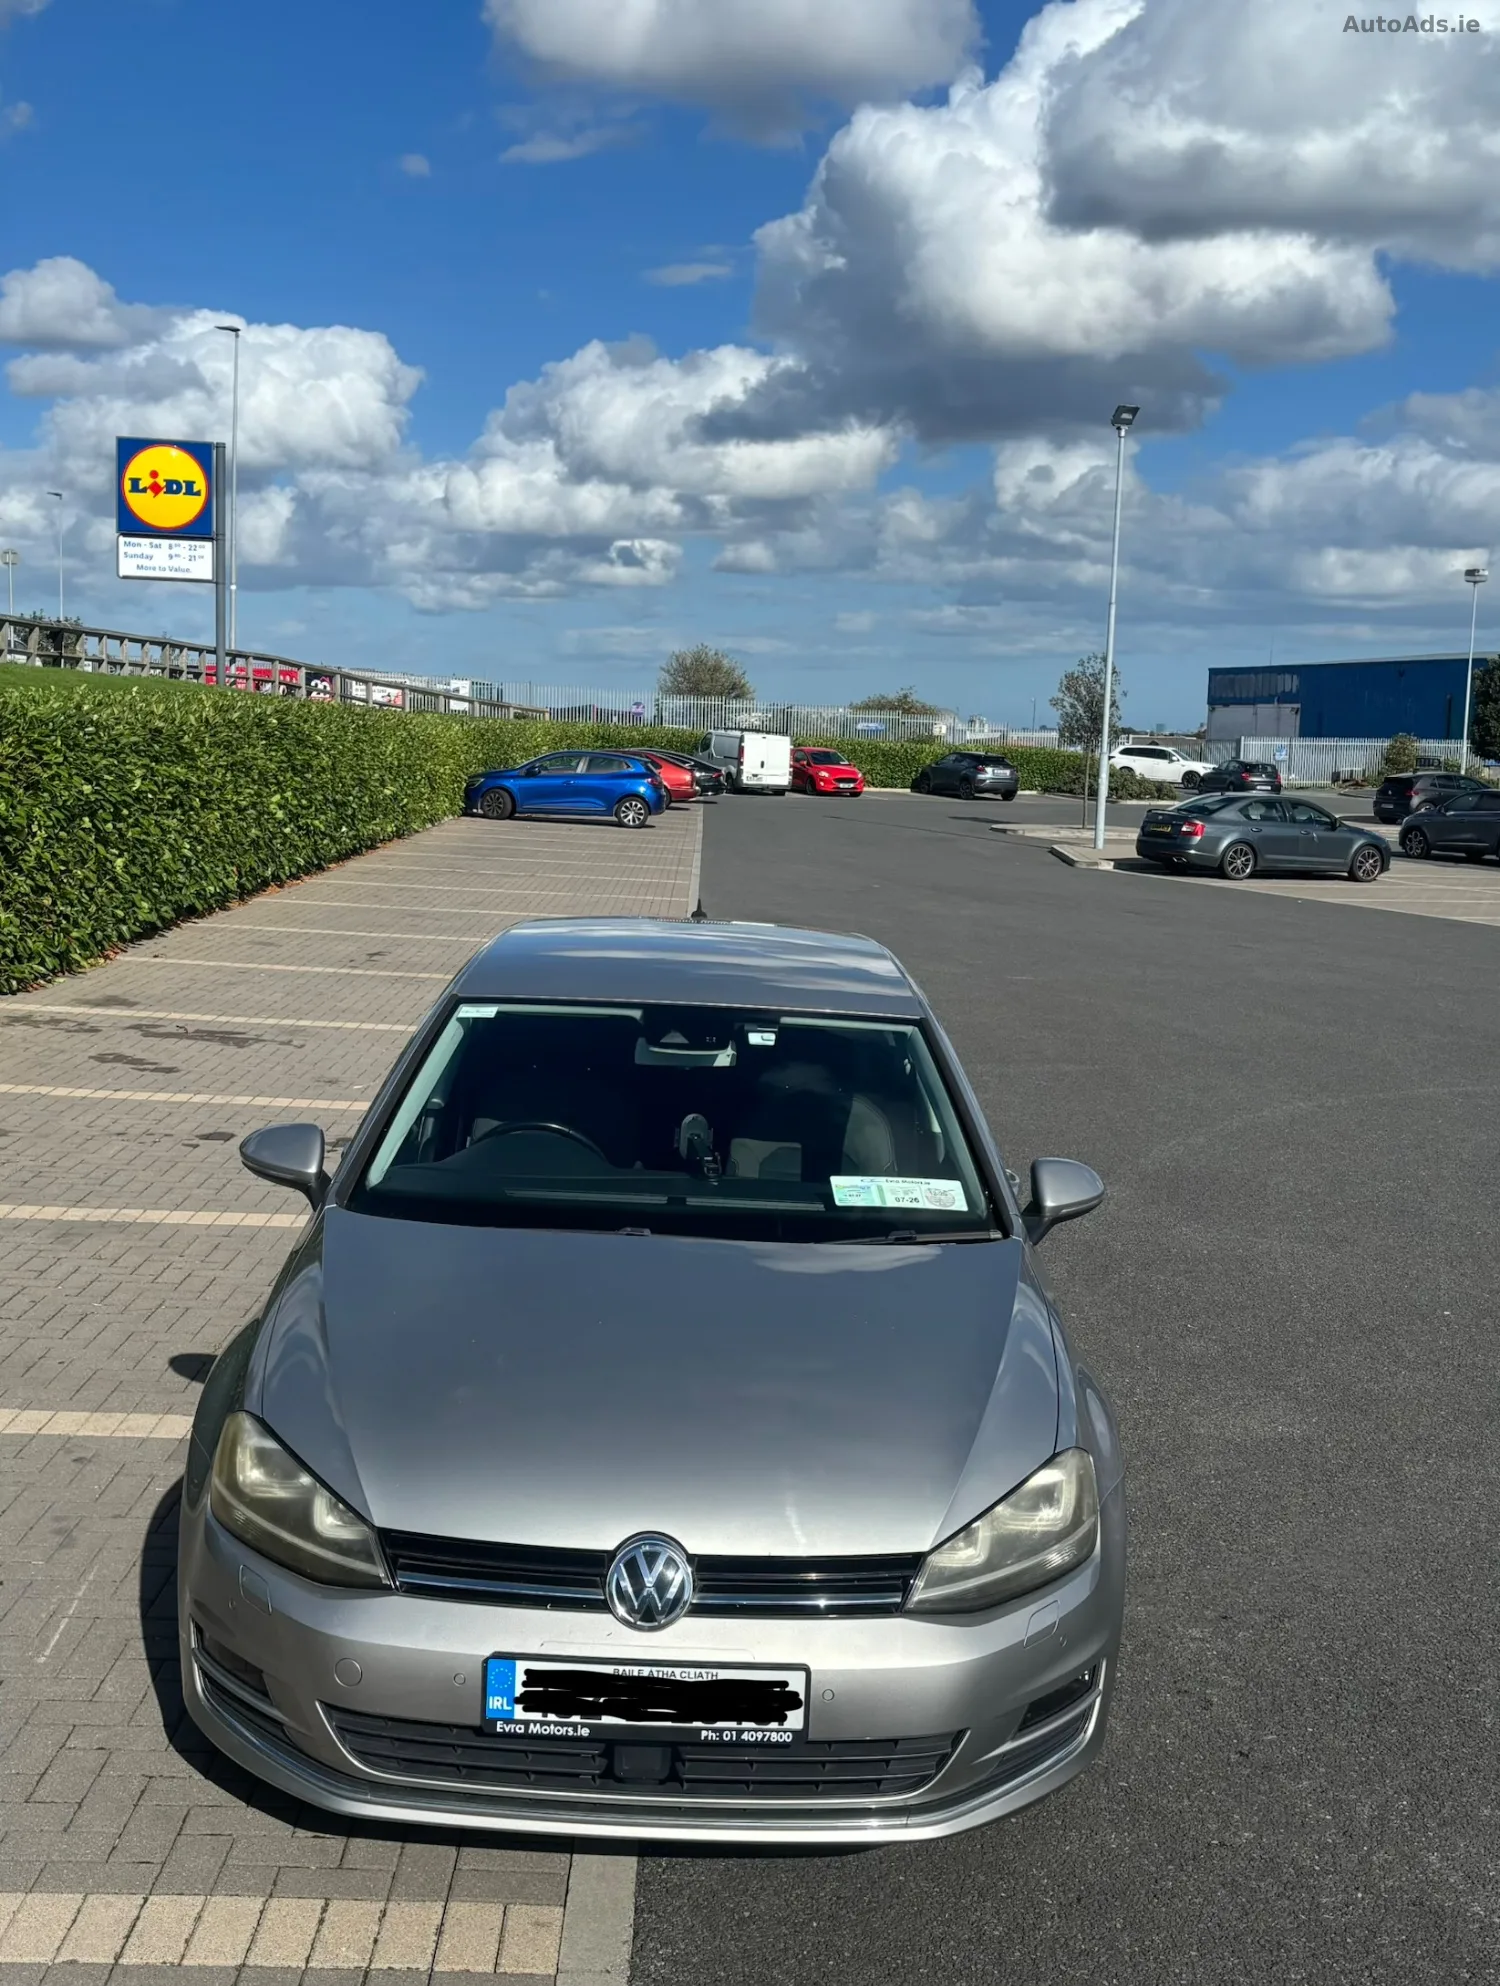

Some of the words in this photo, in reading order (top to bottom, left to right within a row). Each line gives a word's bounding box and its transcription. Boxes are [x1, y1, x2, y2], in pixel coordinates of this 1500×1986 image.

[123, 540, 142, 548] Mon
[149, 541, 162, 549] Sat
[123, 551, 154, 561] Sunday
[613, 1668, 645, 1677] BAILE
[680, 1670, 719, 1680] CLIATH
[488, 1696, 513, 1711] IRL
[496, 1720, 525, 1734] Evra
[528, 1722, 591, 1737] Motors.ie
[701, 1730, 720, 1741] Ph:
[722, 1730, 737, 1742] 01
[740, 1731, 793, 1743] 4097800
